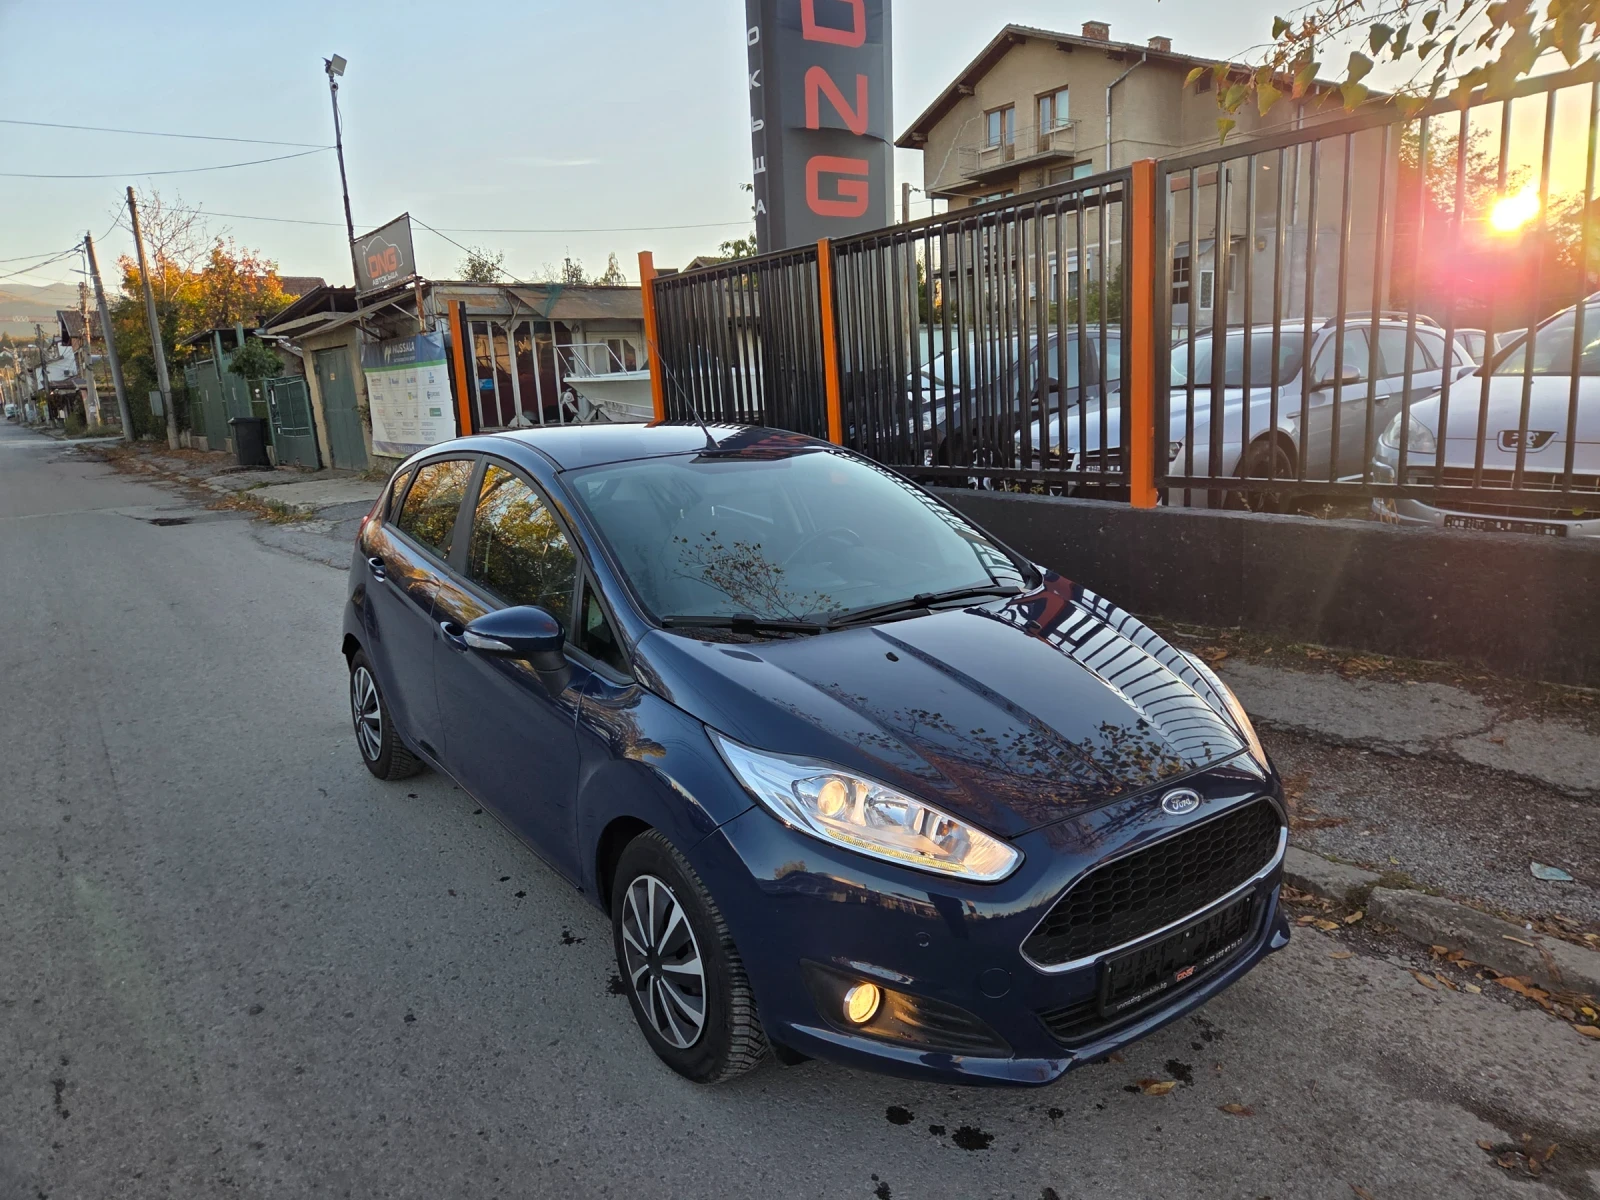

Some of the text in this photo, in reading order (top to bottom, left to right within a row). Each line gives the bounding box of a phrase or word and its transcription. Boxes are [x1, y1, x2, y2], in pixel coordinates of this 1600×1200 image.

[801, 0, 869, 218] DNG
[368, 247, 397, 279] DNG
[1171, 794, 1192, 810] Ford
